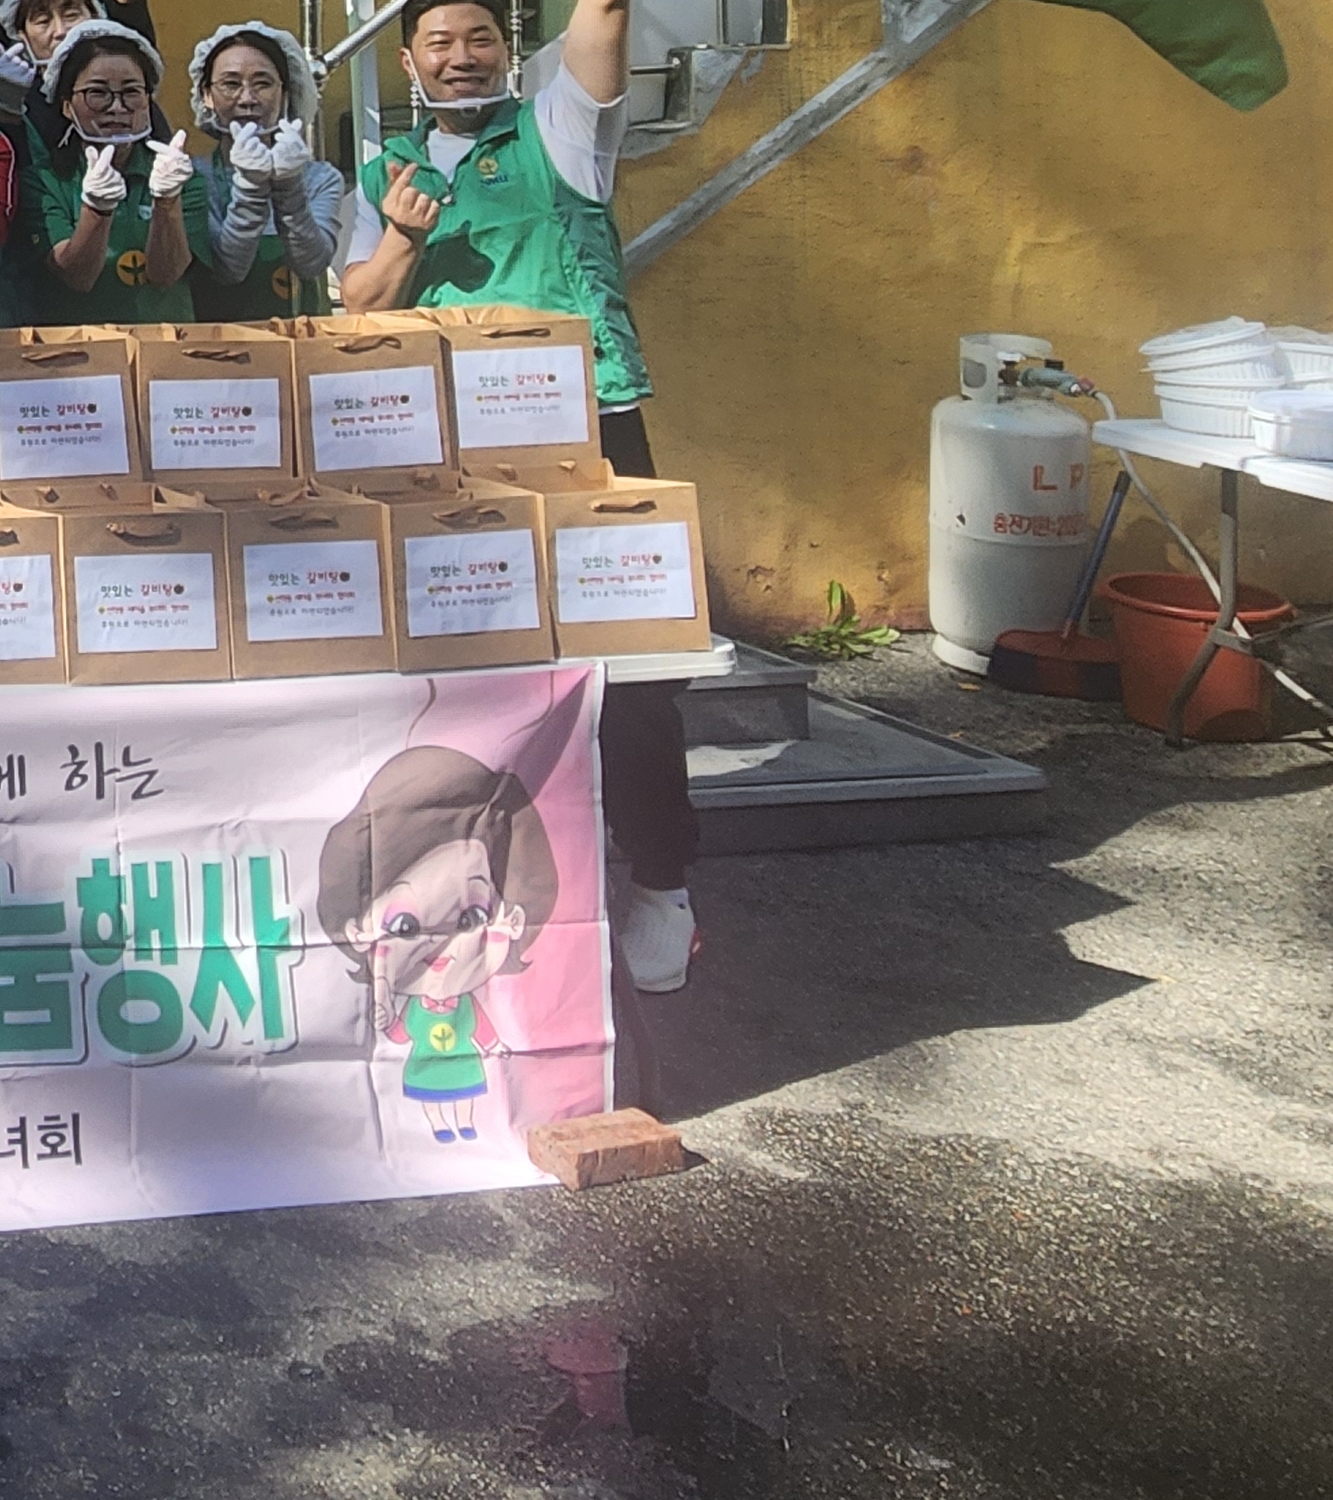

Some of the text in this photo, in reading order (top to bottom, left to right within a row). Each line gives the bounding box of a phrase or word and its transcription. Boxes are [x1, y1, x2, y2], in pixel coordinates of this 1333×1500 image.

[516, 375, 545, 385] 갈비탕
[371, 396, 399, 406] 갈비탕
[57, 404, 87, 415] 갈비탕
[210, 407, 240, 418] 갈비탕
[621, 555, 650, 566] 갈비탕
[468, 563, 498, 575] 갈비탕
[307, 572, 338, 584] 갈비탕
[141, 584, 172, 596] 갈비탕
[63, 741, 166, 800] 하는
